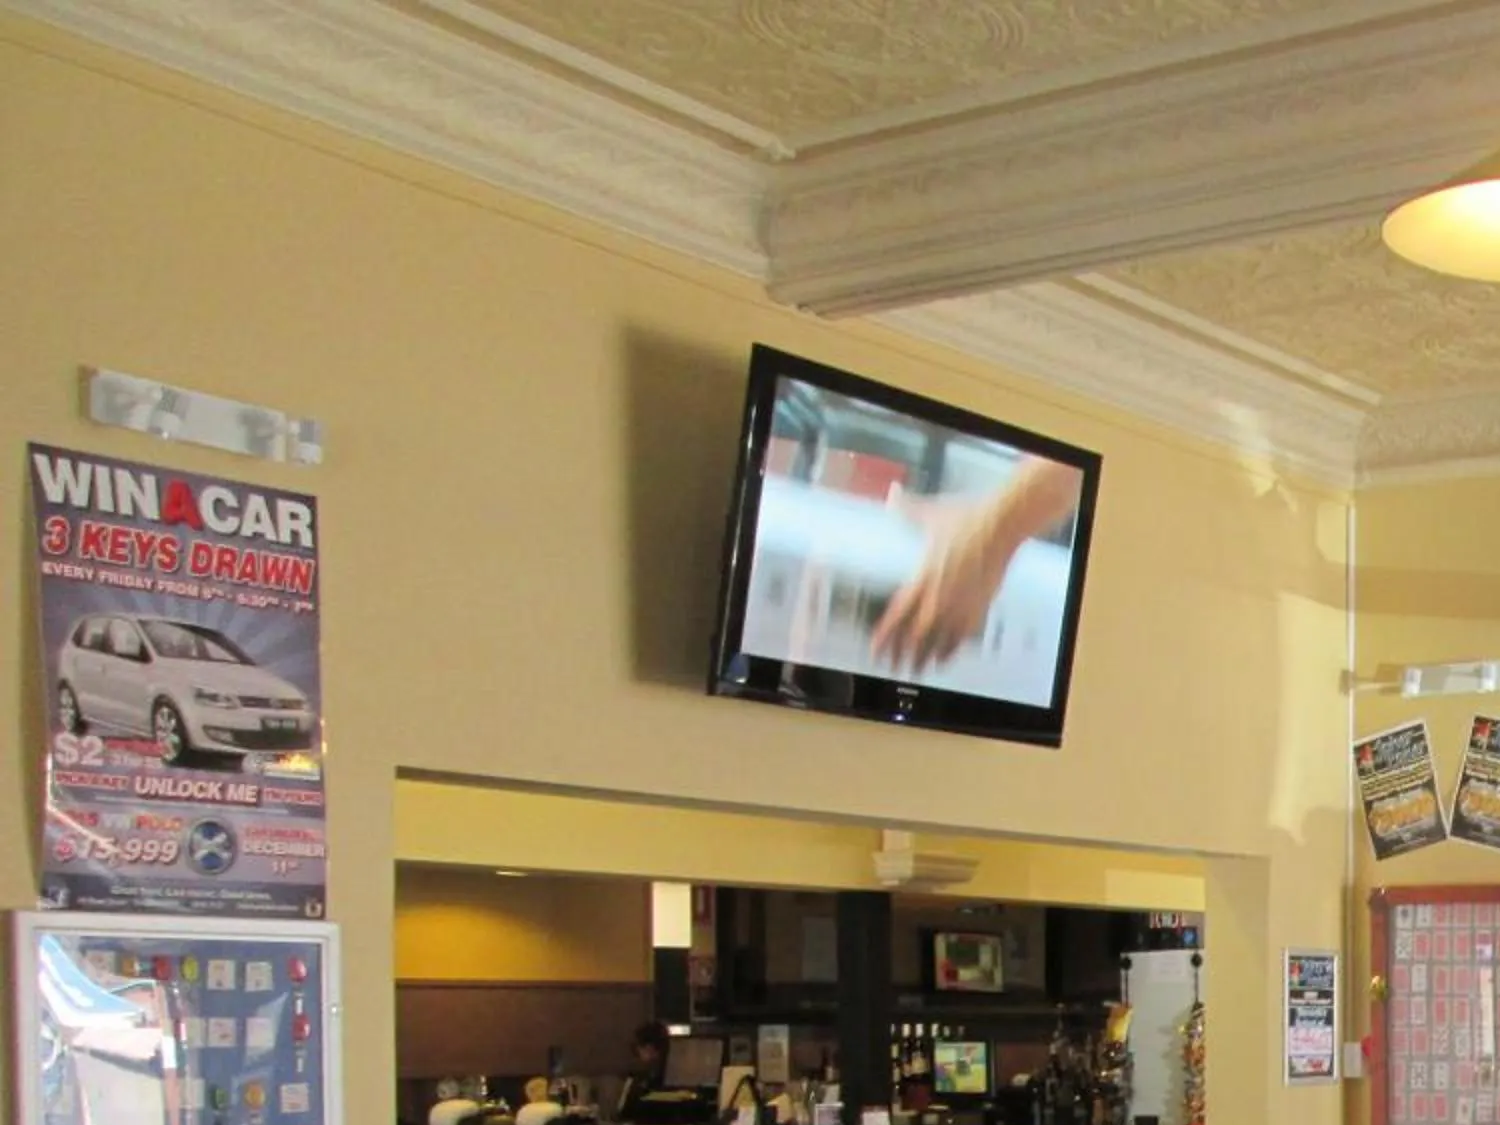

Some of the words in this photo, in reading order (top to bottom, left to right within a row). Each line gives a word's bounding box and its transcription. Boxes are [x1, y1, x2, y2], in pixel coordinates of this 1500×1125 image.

[33, 453, 160, 521] WIN
[162, 479, 203, 531] A
[200, 486, 314, 547] CAR
[44, 516, 69, 554] 3
[79, 521, 180, 573] KEYS
[190, 543, 315, 594] DRAWN
[42, 561, 94, 582] EVERY
[100, 570, 152, 589] FRIDAY
[157, 580, 199, 597] FROM
[54, 732, 104, 766] $2
[135, 775, 223, 800] UNLOCK
[226, 783, 258, 803] ME
